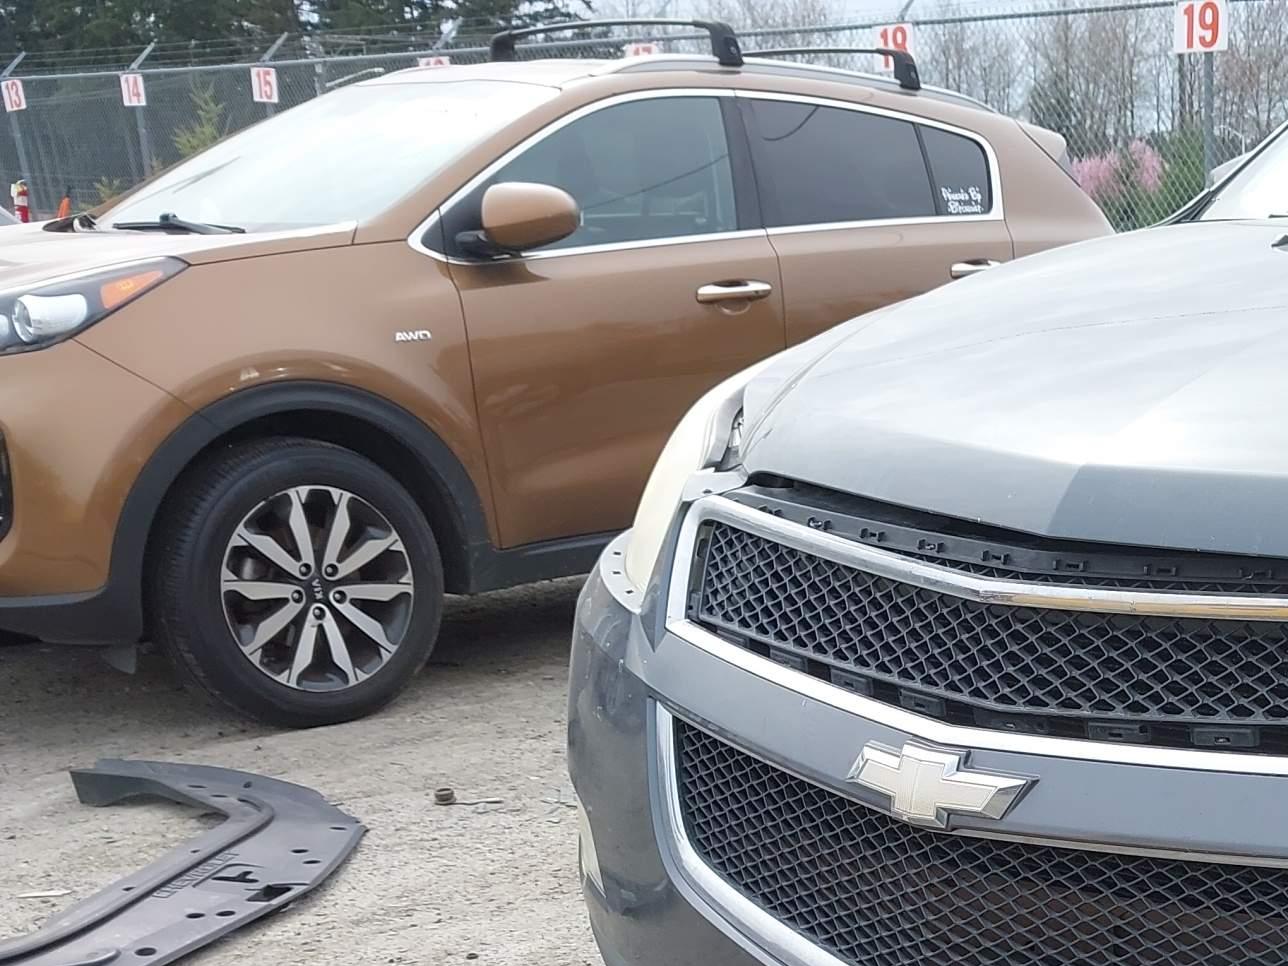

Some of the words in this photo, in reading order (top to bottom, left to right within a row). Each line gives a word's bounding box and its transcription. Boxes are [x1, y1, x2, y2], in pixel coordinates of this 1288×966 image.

[1183, 1, 1219, 48] 19
[5, 80, 22, 109] 13
[125, 76, 141, 103] 14
[256, 70, 273, 100] 15
[395, 330, 431, 341] AWD
[311, 578, 323, 600] KIA
